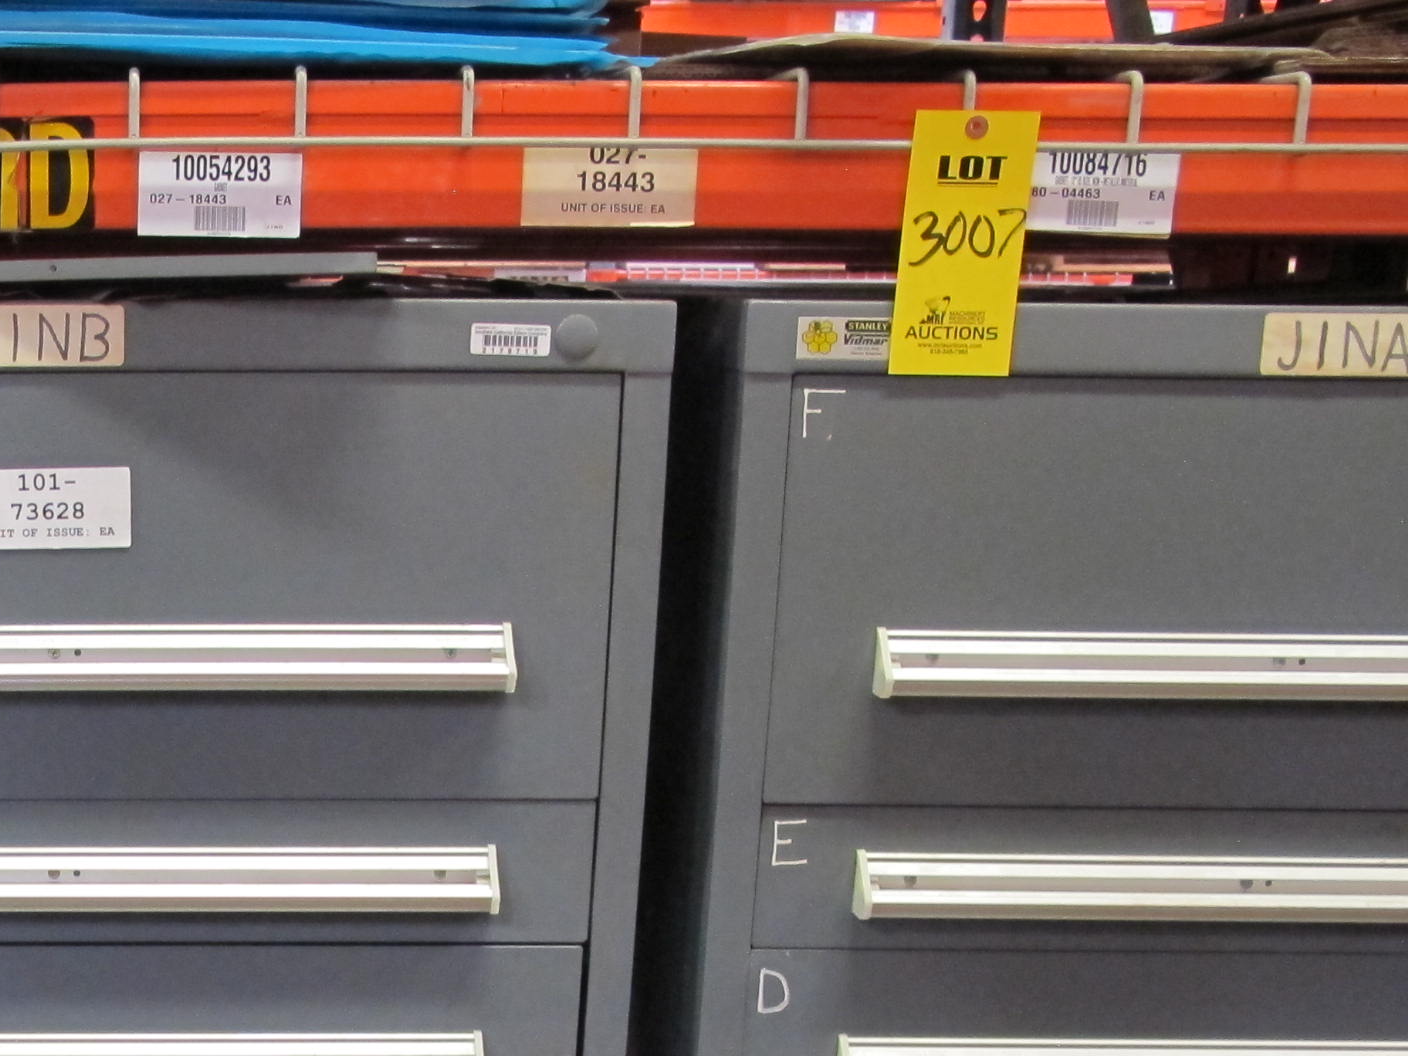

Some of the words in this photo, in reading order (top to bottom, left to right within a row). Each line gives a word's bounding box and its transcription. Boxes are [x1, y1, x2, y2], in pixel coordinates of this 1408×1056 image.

[171, 153, 272, 183] 10054293
[936, 155, 1009, 181] LOT
[1048, 151, 1148, 177] 10084716
[576, 170, 655, 193] 18443
[275, 194, 292, 206] EA
[1148, 190, 1166, 201] EA
[560, 202, 587, 213] UNIT
[590, 204, 607, 213] OF
[650, 204, 666, 214] EA
[908, 207, 1028, 267] 3007
[847, 321, 888, 331] STANLEY
[904, 325, 999, 341] AUCTIONS
[843, 333, 889, 346] Vidmar
[1276, 319, 1408, 374] JINA
[802, 387, 848, 439] F
[17, 472, 77, 492] 101-
[10, 501, 85, 521] 73628
[22, 528, 39, 538] OF
[99, 526, 116, 537] EA
[770, 818, 808, 867] E
[756, 967, 791, 1015] D
